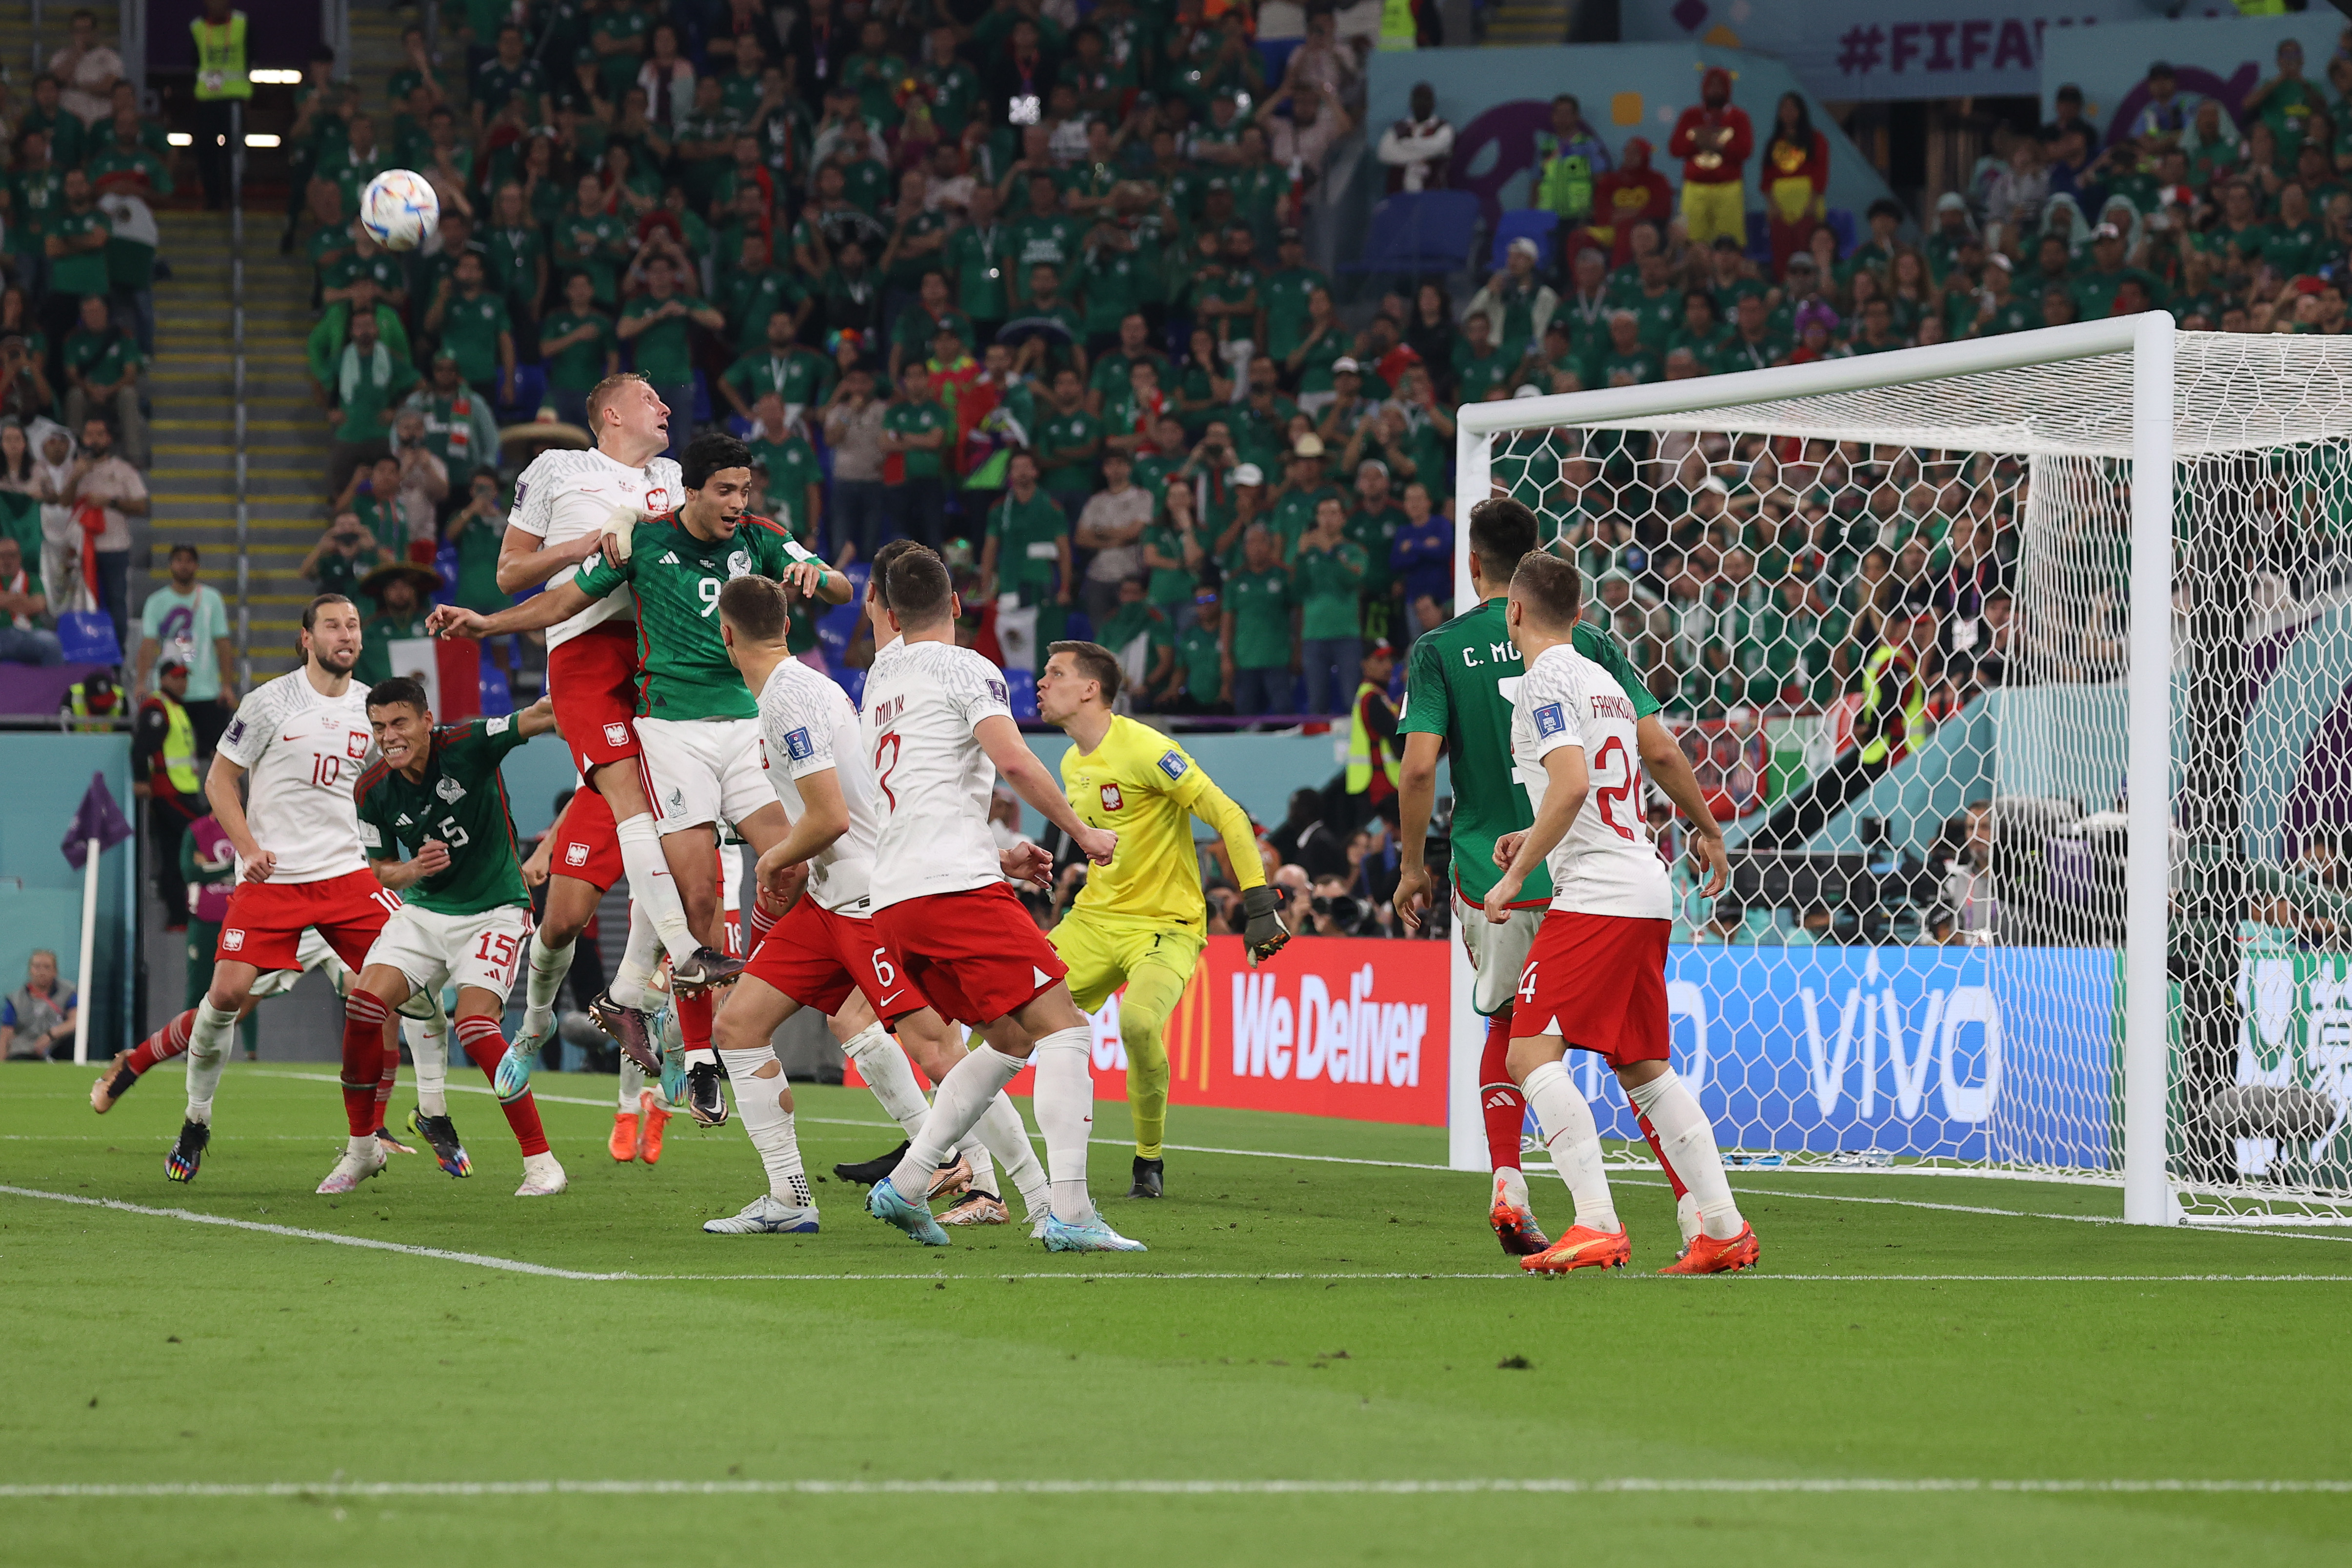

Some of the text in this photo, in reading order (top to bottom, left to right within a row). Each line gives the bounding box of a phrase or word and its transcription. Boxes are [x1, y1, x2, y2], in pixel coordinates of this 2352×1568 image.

[1838, 18, 2048, 76] #FIFA
[698, 577, 721, 617] 9
[1462, 647, 1484, 667] C.
[875, 694, 904, 727] MILIK
[312, 753, 339, 786] 10
[369, 887, 403, 915] 10
[475, 931, 517, 967] 15
[1154, 933, 1161, 948] 1
[872, 947, 895, 987] 6
[1518, 961, 1539, 1003] 4
[1232, 972, 1294, 1080] We
[1296, 962, 1428, 1088] Deliver
[1801, 948, 2001, 1123] vivo
